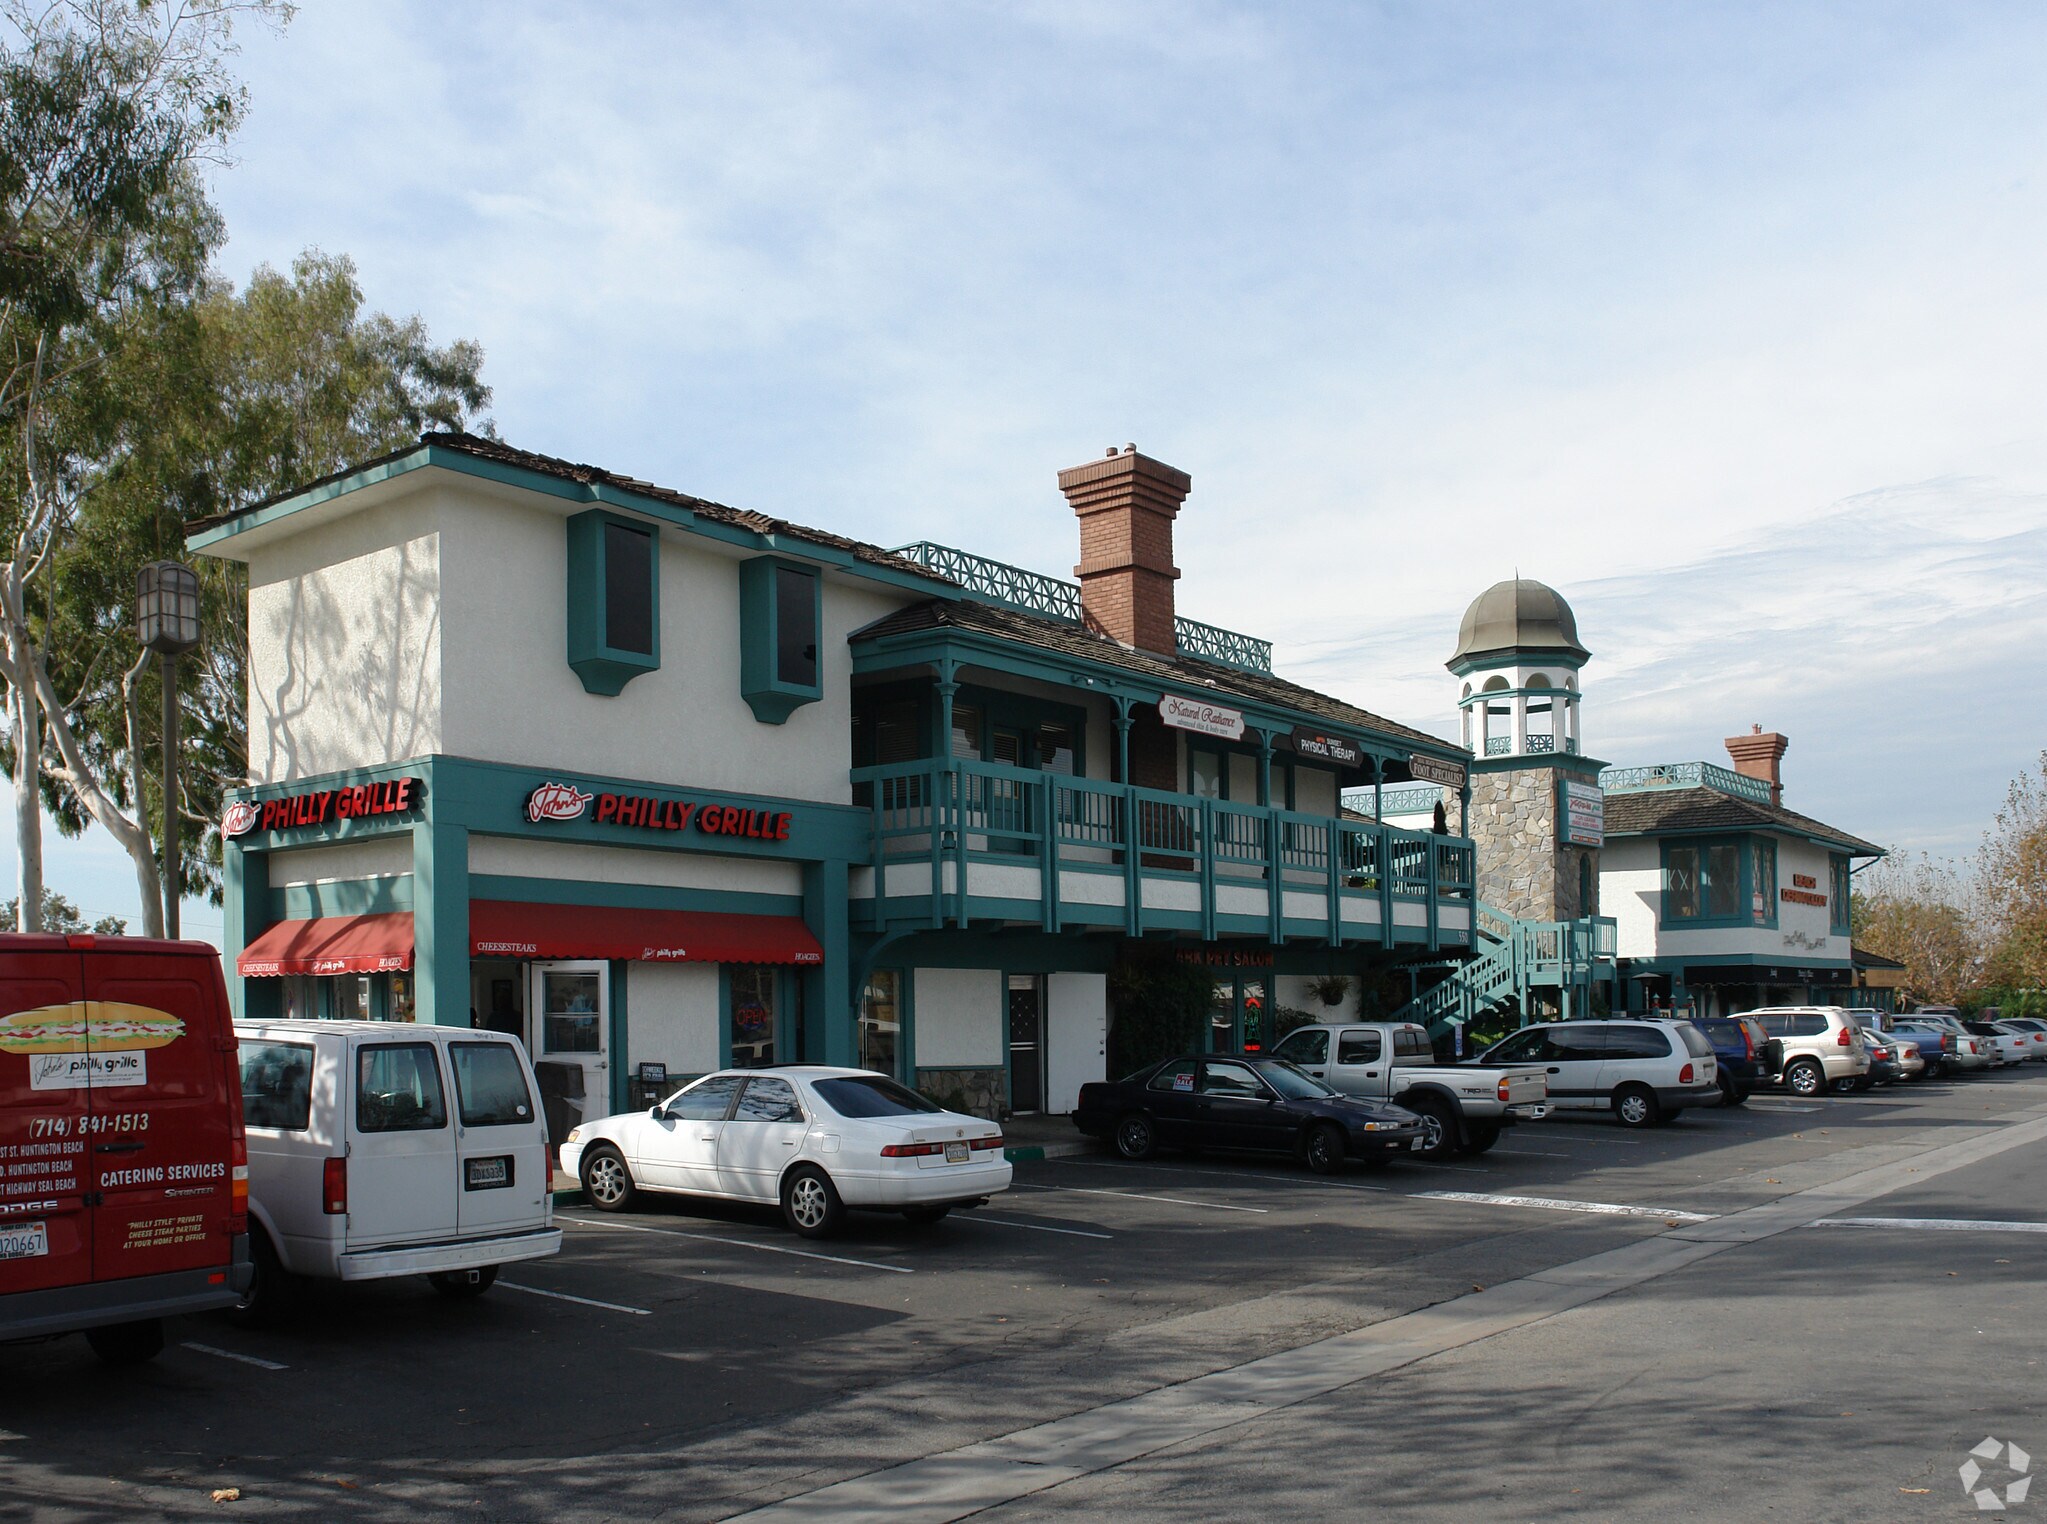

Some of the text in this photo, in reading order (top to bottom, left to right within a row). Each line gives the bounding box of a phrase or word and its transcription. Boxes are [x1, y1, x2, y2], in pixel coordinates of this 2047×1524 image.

[1169, 699, 1235, 727] Natural Radiance
[1301, 739, 1329, 755] PHYSICAL
[1331, 746, 1355, 761] THERAPY
[1413, 762, 1430, 777] FOOT
[1431, 767, 1463, 784] SPECIALIST
[262, 790, 331, 830] PHILLY
[335, 777, 412, 819] GRILLE
[596, 793, 695, 830] PHILLY
[701, 805, 793, 840] GRILLE
[477, 942, 537, 953] CHEESESTEAKS
[794, 952, 820, 961] HOAGIES
[1206, 949, 1230, 966] PET
[1233, 950, 1274, 967] SALON
[242, 963, 279, 973] CHEESESTEAKS
[736, 1008, 767, 1024] OPEN
[69, 1057, 102, 1074] philly
[105, 1056, 138, 1072] grille
[1461, 1087, 1482, 1095] TRD
[29, 1113, 149, 1139] (714) 841-1513
[9, 1145, 18, 1158] ST.
[20, 1142, 61, 1157] HUNTINGTON
[63, 1141, 84, 1154] BEACH
[8, 1161, 50, 1177] HUNTINGTON
[51, 1159, 73, 1173] BEACH
[101, 1162, 225, 1187] CATERING SERVICES
[6, 1181, 36, 1195] HIGHWAY
[38, 1179, 54, 1193] SEAL
[55, 1177, 77, 1191] BEACH
[177, 1214, 203, 1223] PRIVATE
[128, 1224, 201, 1239] CHEESE STEAK PARTIES
[134, 1239, 151, 1248] YOUR
[153, 1236, 172, 1245] HOME
[185, 1233, 206, 1241] OFFICE
